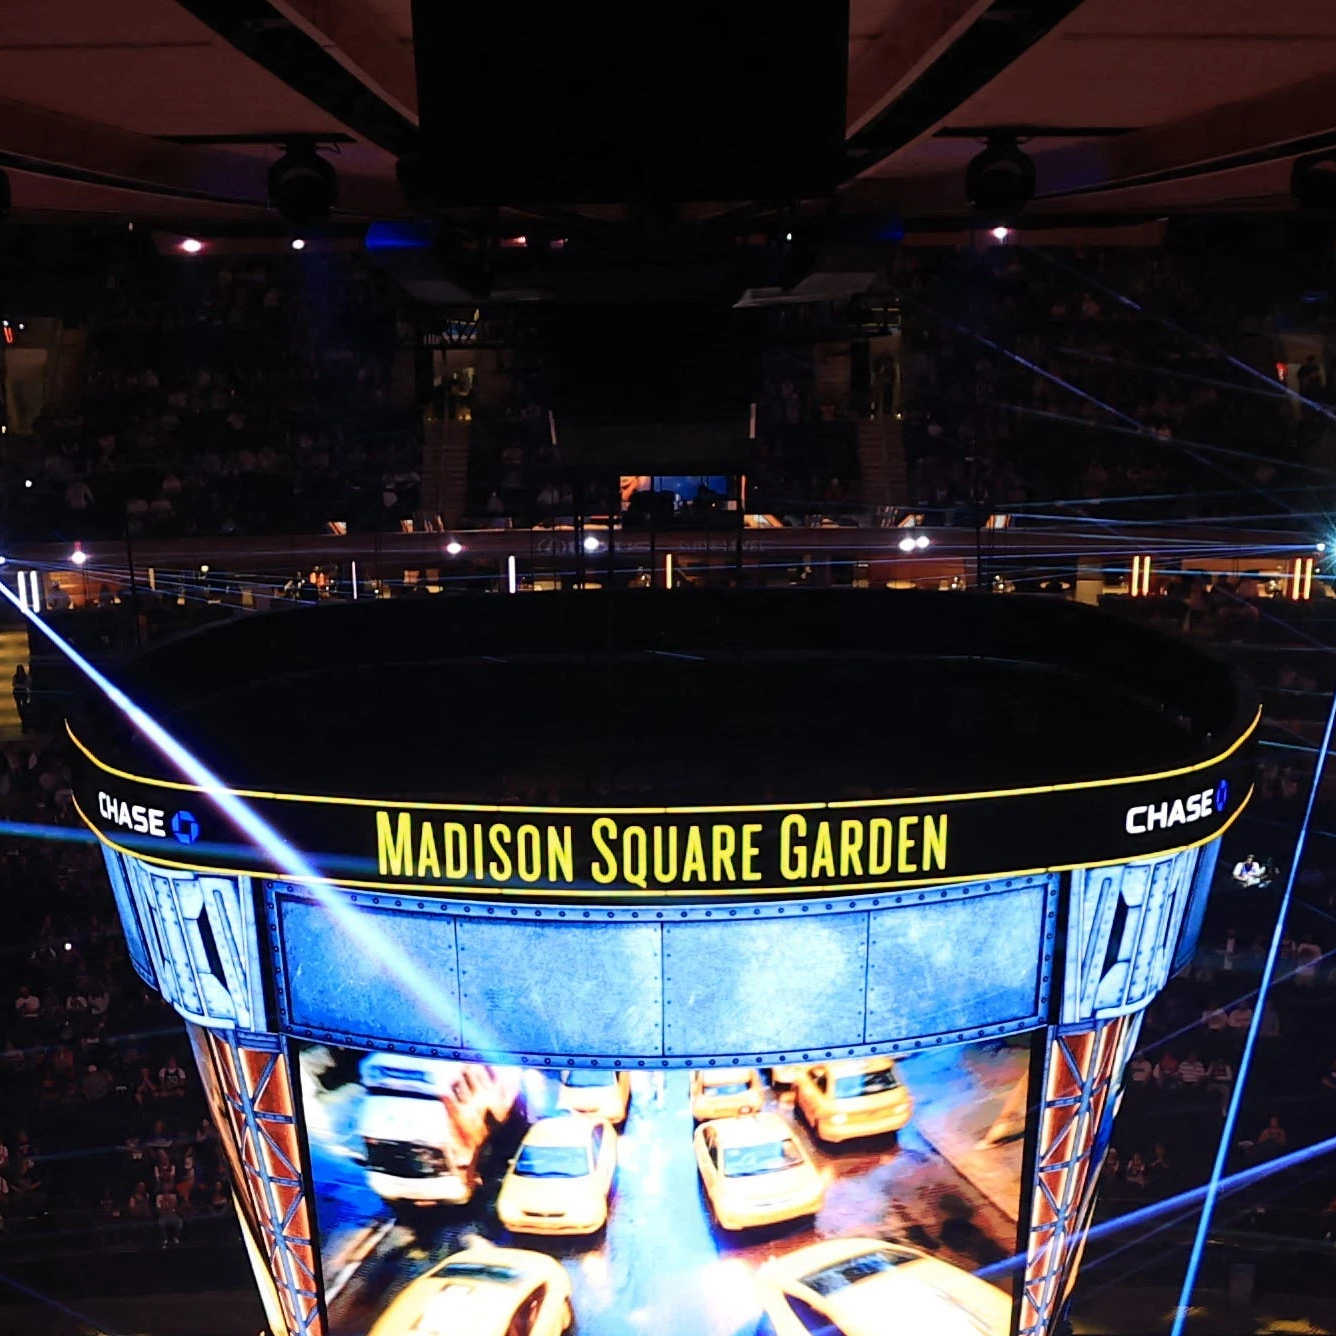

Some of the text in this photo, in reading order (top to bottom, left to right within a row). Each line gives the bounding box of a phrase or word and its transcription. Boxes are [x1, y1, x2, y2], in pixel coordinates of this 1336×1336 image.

[98, 791, 166, 837] CHASE
[1126, 788, 1214, 834] CHASE
[376, 811, 947, 888] MADISON SQUARE GARDEN
